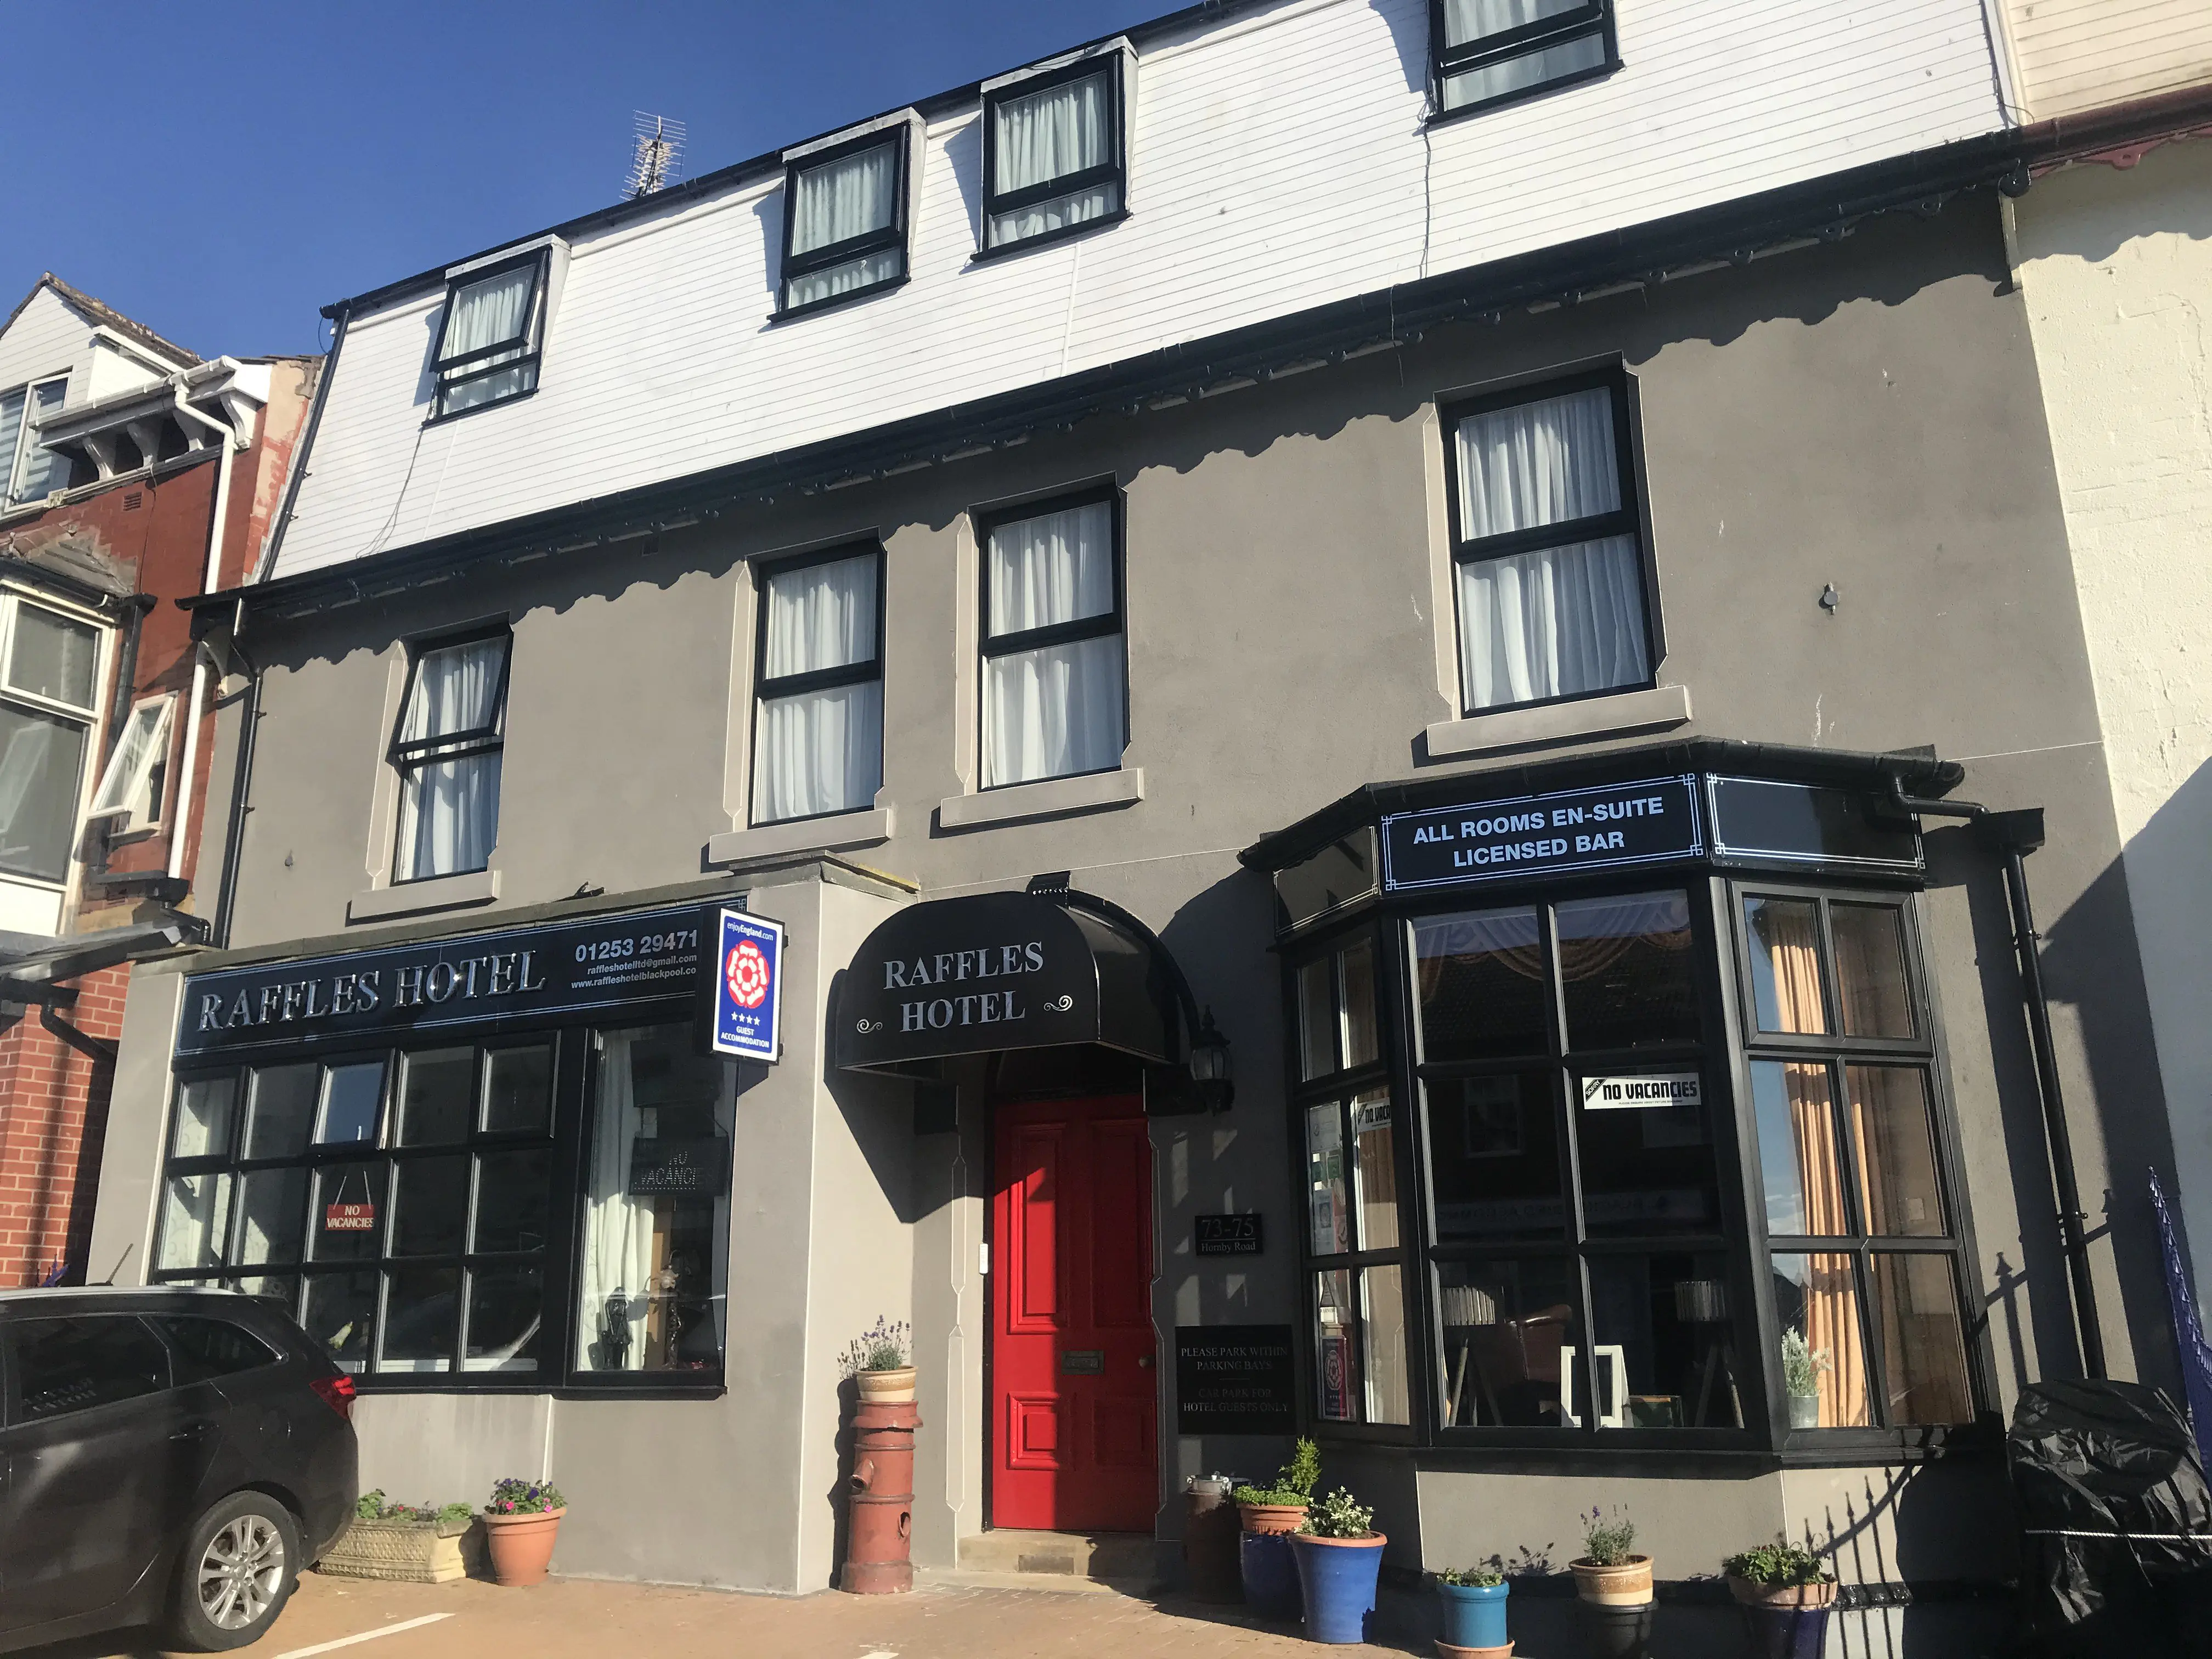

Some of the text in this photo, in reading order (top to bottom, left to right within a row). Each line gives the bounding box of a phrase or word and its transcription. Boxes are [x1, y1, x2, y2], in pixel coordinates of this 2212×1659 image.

[1413, 797, 1663, 845] ALL ROOMS EN-SUITE
[1453, 831, 1625, 867] LICENSED BAR
[727, 922, 774, 941] enjoyEngland.com
[575, 929, 697, 962] 01253 29471
[587, 955, 697, 975] raffleshotelltd@gmail.com
[883, 941, 1043, 990] RAFFLES
[571, 967, 696, 989] www.raffleshotelblackpool.co
[197, 950, 547, 1031] RAFFLES HOTEL
[900, 990, 1025, 1032] HOTEL
[720, 1032, 770, 1048] ACCOMMODATION
[736, 1026, 754, 1036] GUEST
[1603, 1081, 1697, 1100] NO VACANCIES
[1365, 1108, 1373, 1124] NO
[345, 1205, 360, 1216] NO
[327, 1217, 374, 1228] VACANCIES
[1201, 1217, 1254, 1238] 73-75
[1201, 1242, 1256, 1253] Hornby Road
[1181, 1346, 1288, 1357] PLEASE PARK WITHIN
[1197, 1361, 1273, 1370] PARKING BAYS
[1198, 1388, 1272, 1398] CAR PARK FOR
[1183, 1402, 1289, 1412] HOTEL GUESTS ONLY
